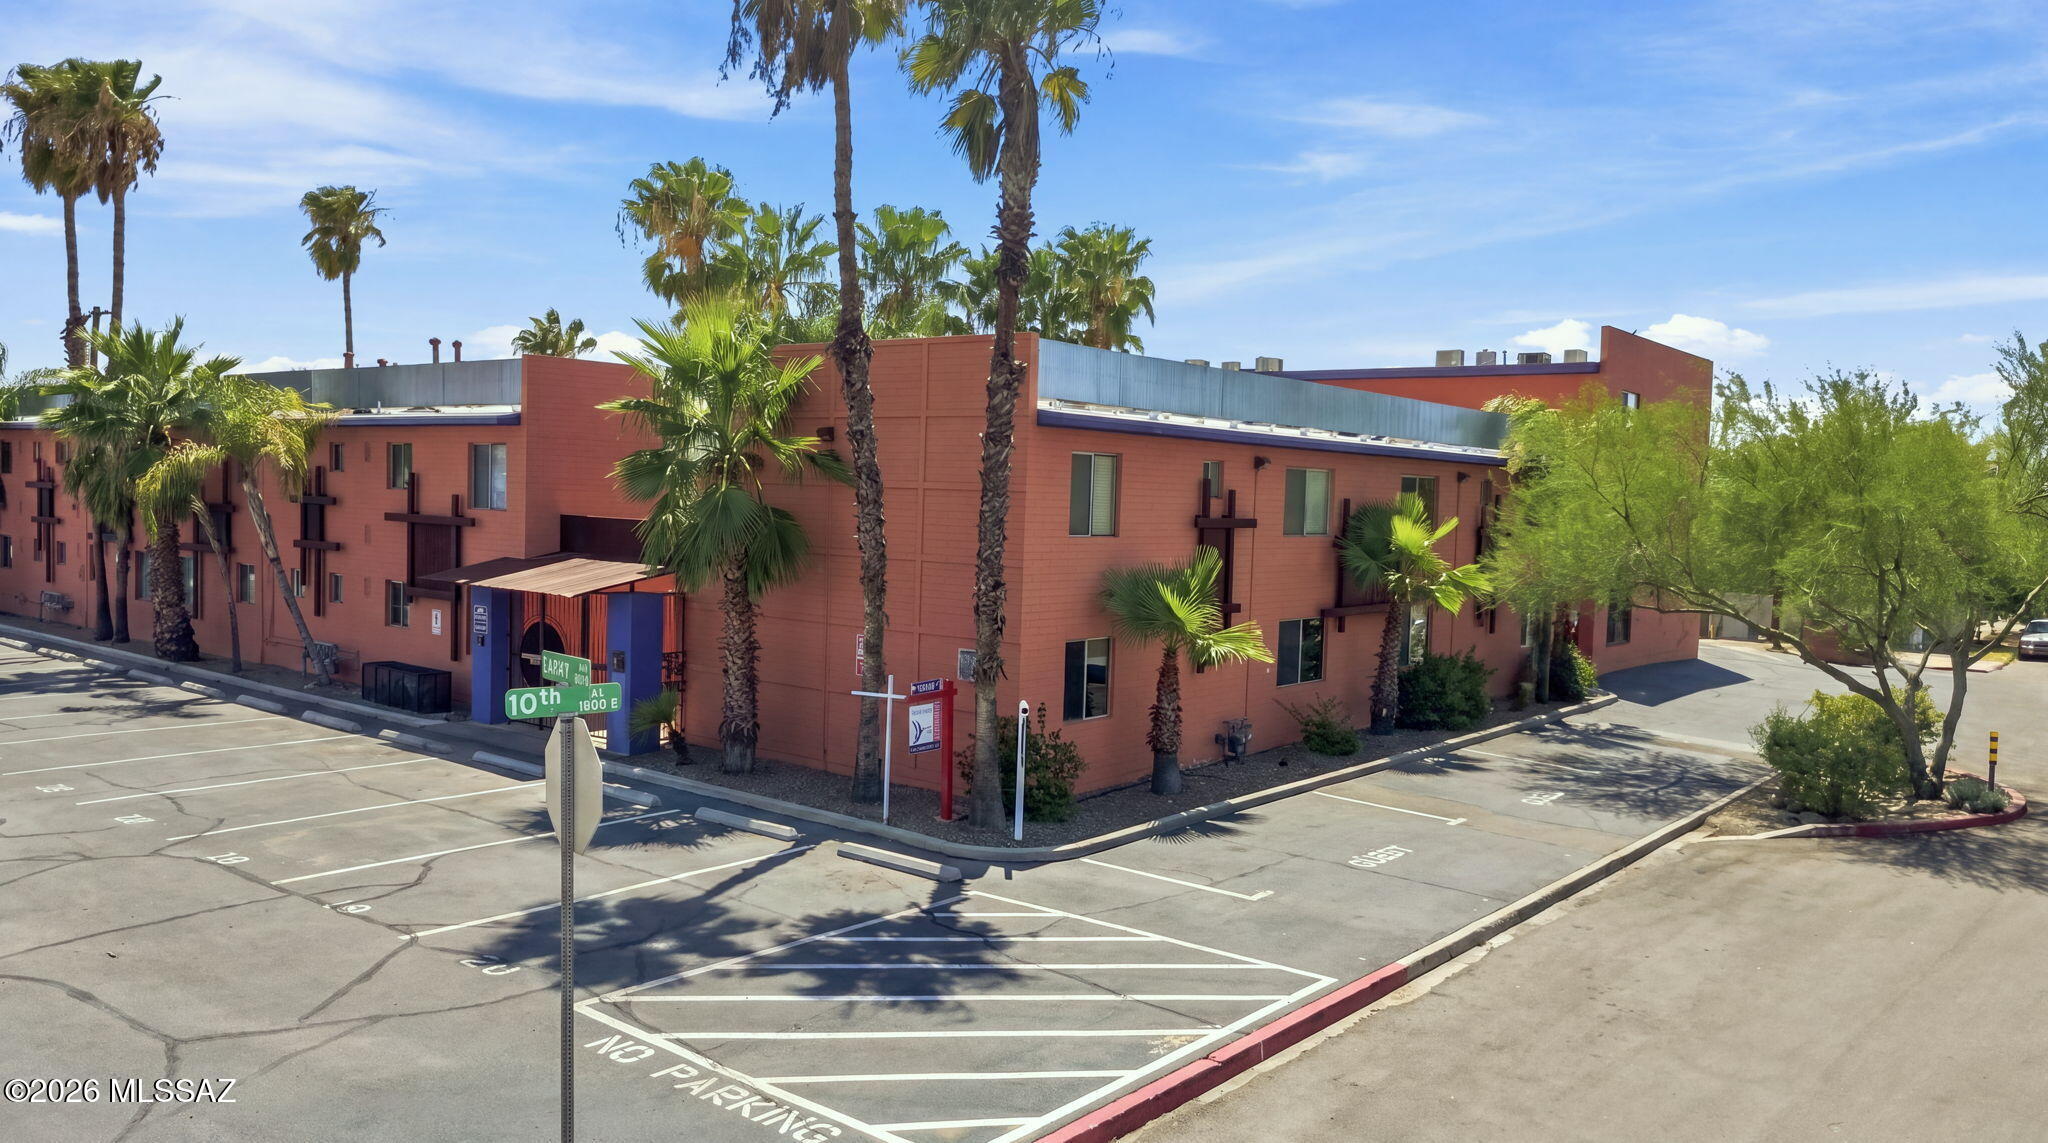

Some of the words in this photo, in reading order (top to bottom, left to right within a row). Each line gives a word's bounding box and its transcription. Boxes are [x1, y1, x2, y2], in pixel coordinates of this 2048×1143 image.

[508, 688, 561, 716] 10th
[591, 688, 604, 698] AL
[579, 700, 607, 712] 1800
[611, 698, 618, 709] E
[1348, 845, 1413, 868] GUEST
[584, 1034, 655, 1063] NO
[650, 1063, 842, 1143] PARKING
